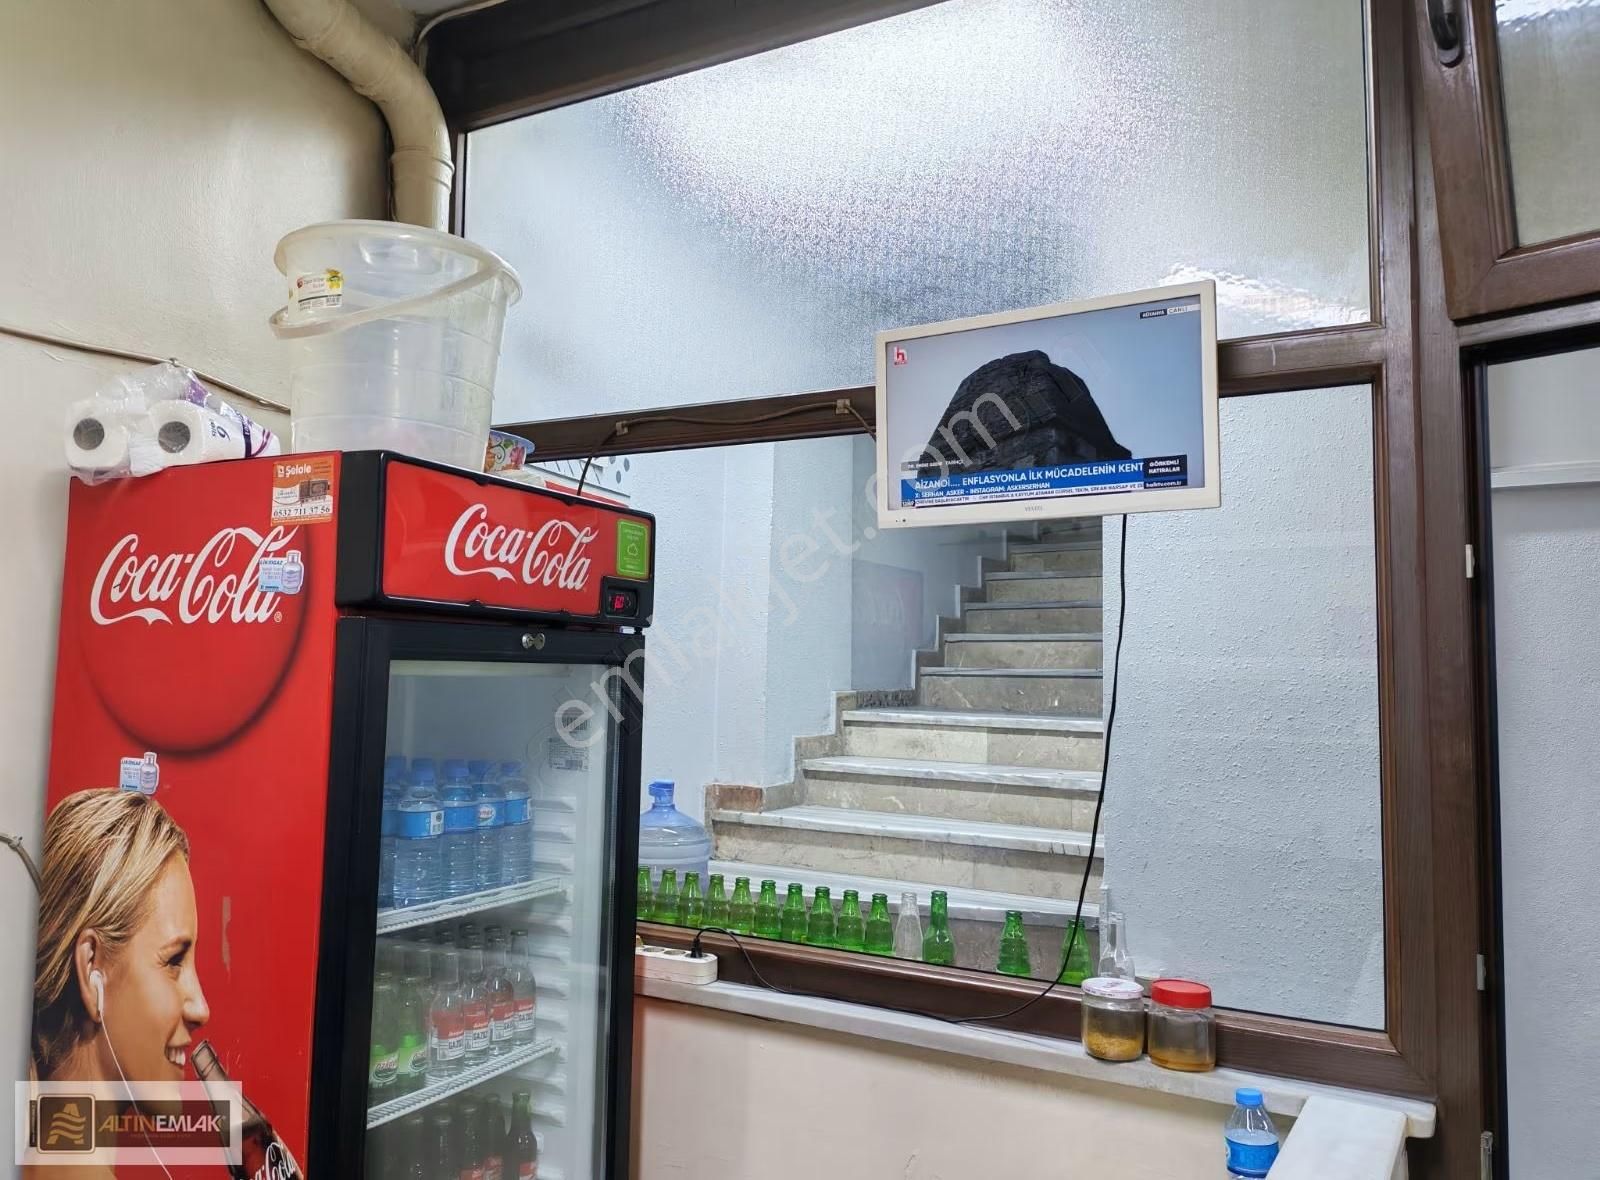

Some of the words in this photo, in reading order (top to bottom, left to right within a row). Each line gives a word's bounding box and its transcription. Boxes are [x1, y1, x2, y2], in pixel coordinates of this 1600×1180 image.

[962, 472, 1027, 486] ENFLASYONLA
[1028, 469, 1043, 480] İLK
[1045, 463, 1116, 479] MÜCADELENİN
[1118, 462, 1144, 473] KENT
[90, 525, 300, 626] Coca-Cola
[444, 503, 599, 591] Coca-Cola
